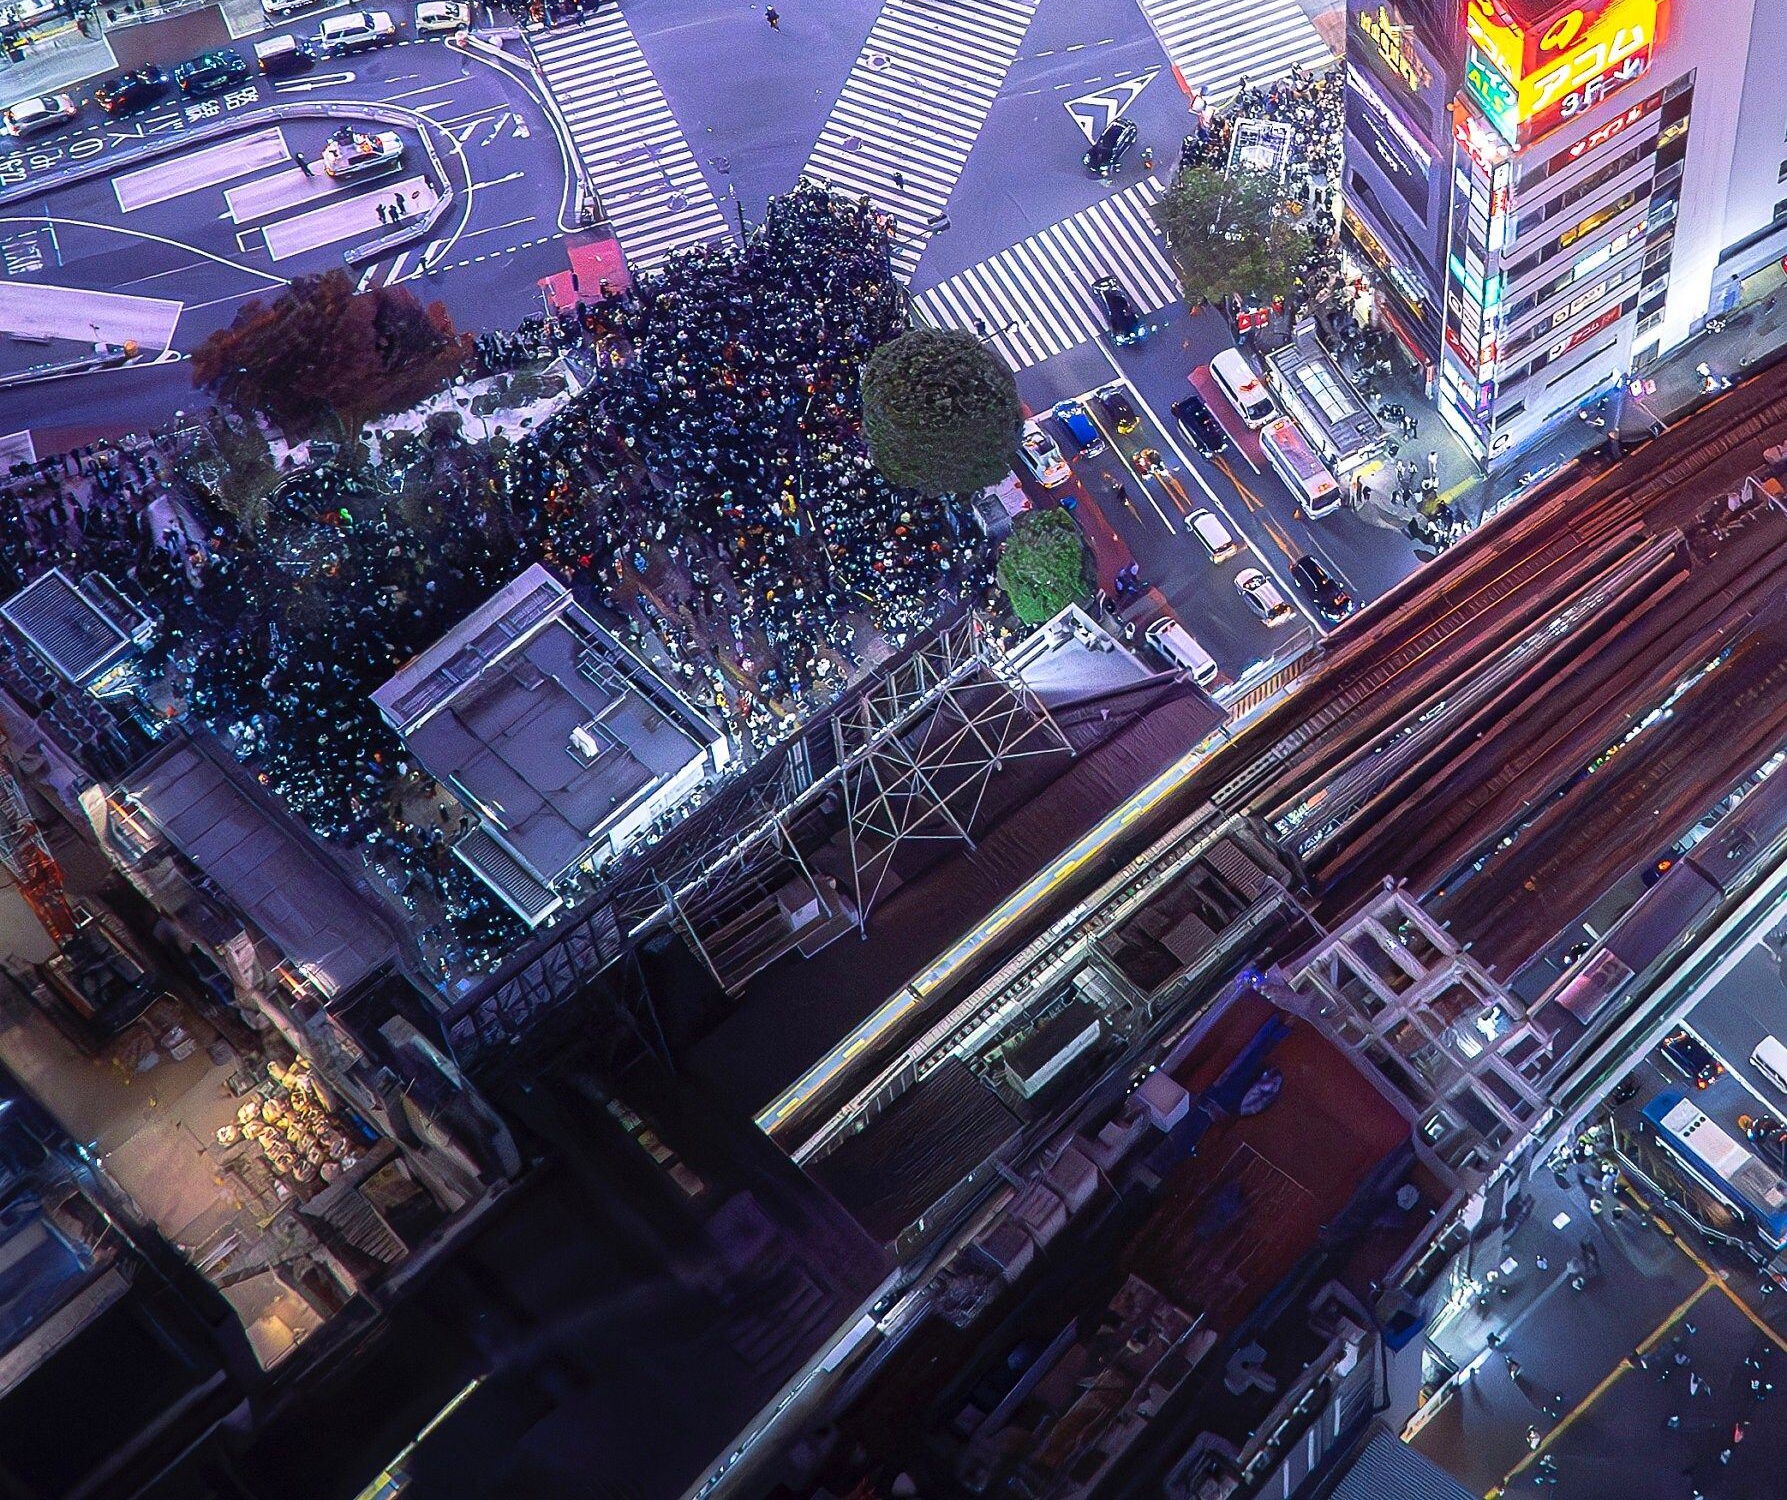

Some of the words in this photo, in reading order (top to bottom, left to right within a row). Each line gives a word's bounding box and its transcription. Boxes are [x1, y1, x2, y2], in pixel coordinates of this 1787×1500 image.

[1532, 25, 1644, 111] アコム
[1468, 69, 1504, 114] ALS
[1560, 75, 1603, 117] 3F
[29, 85, 260, 171] 路線バスのみ
[1588, 108, 1641, 147] アイフル
